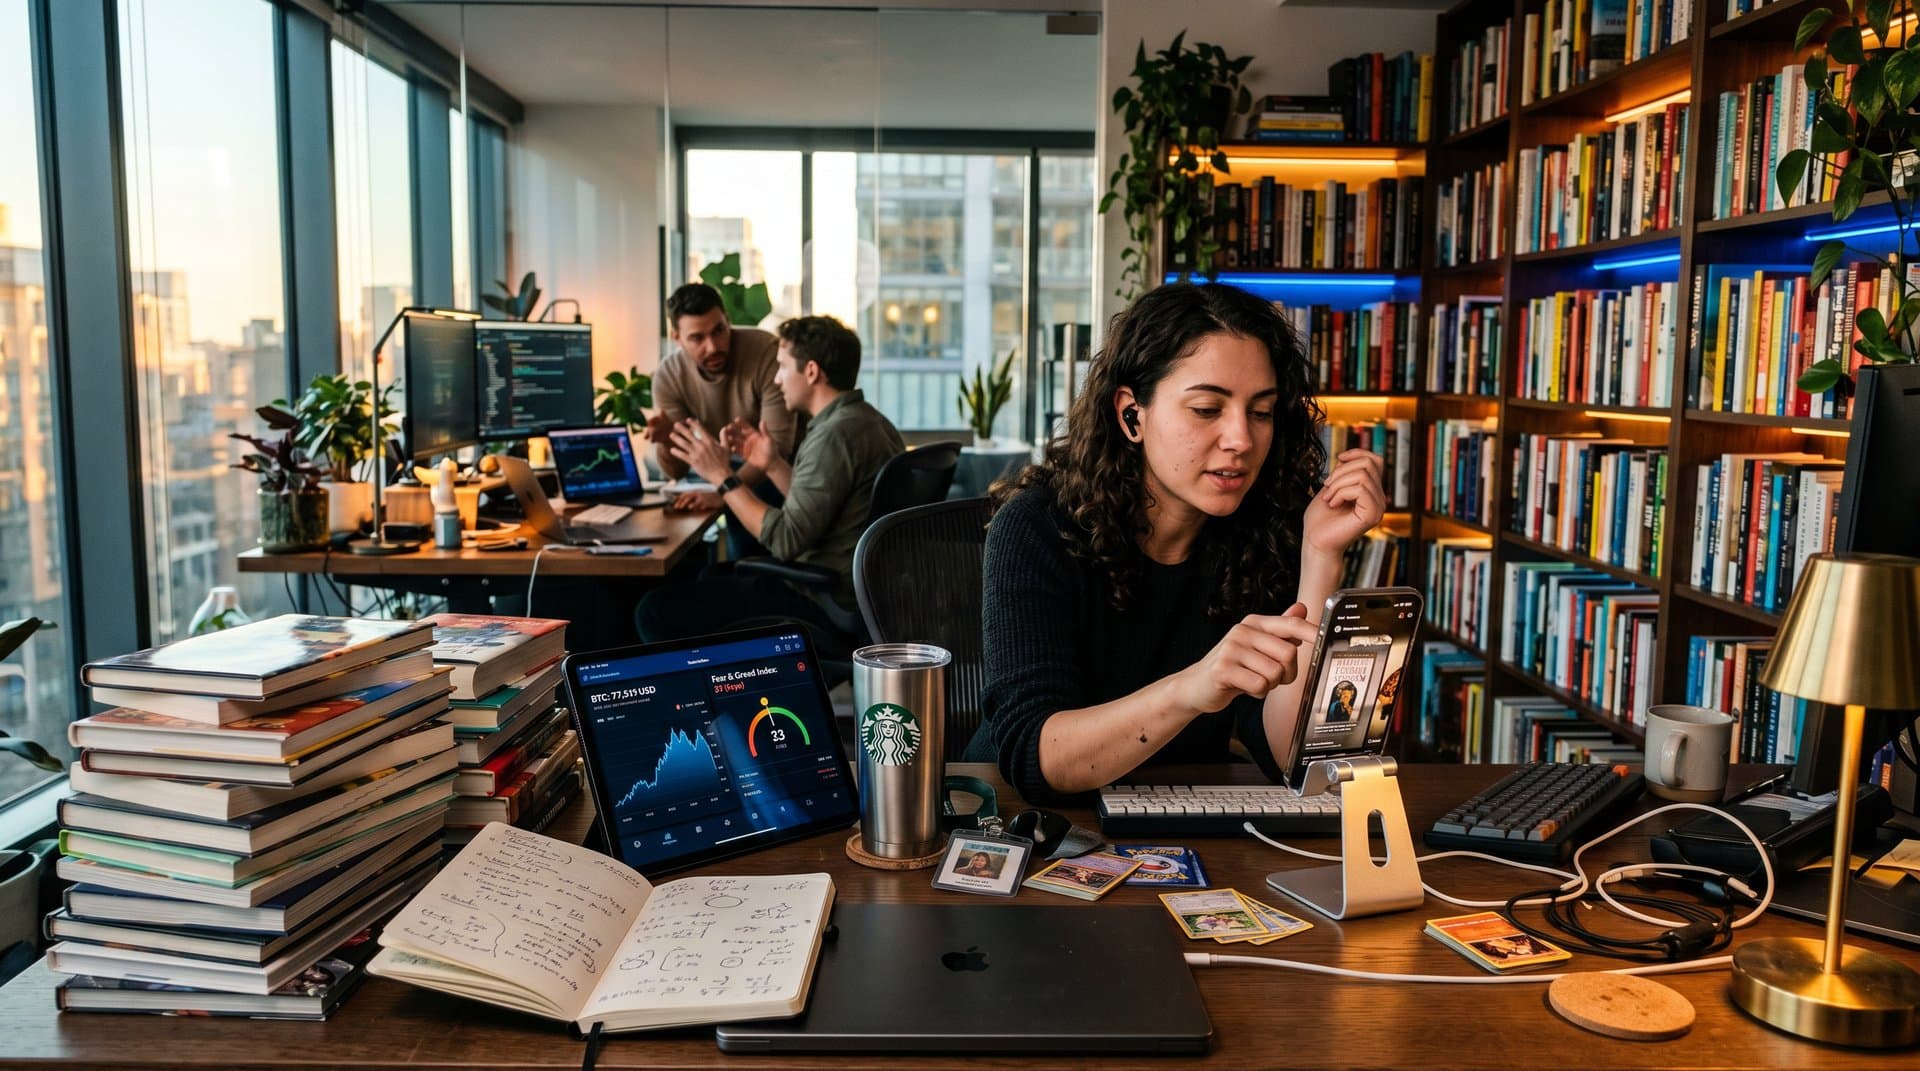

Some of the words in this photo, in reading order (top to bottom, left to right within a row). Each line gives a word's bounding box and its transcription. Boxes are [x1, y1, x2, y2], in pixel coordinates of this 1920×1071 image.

[711, 675, 727, 684] Fear
[727, 673, 734, 681] &
[734, 668, 756, 680] Greed
[590, 693, 611, 704] BTC:
[611, 688, 638, 701] 77,519
[638, 685, 657, 696] USD
[771, 729, 786, 742] 33
